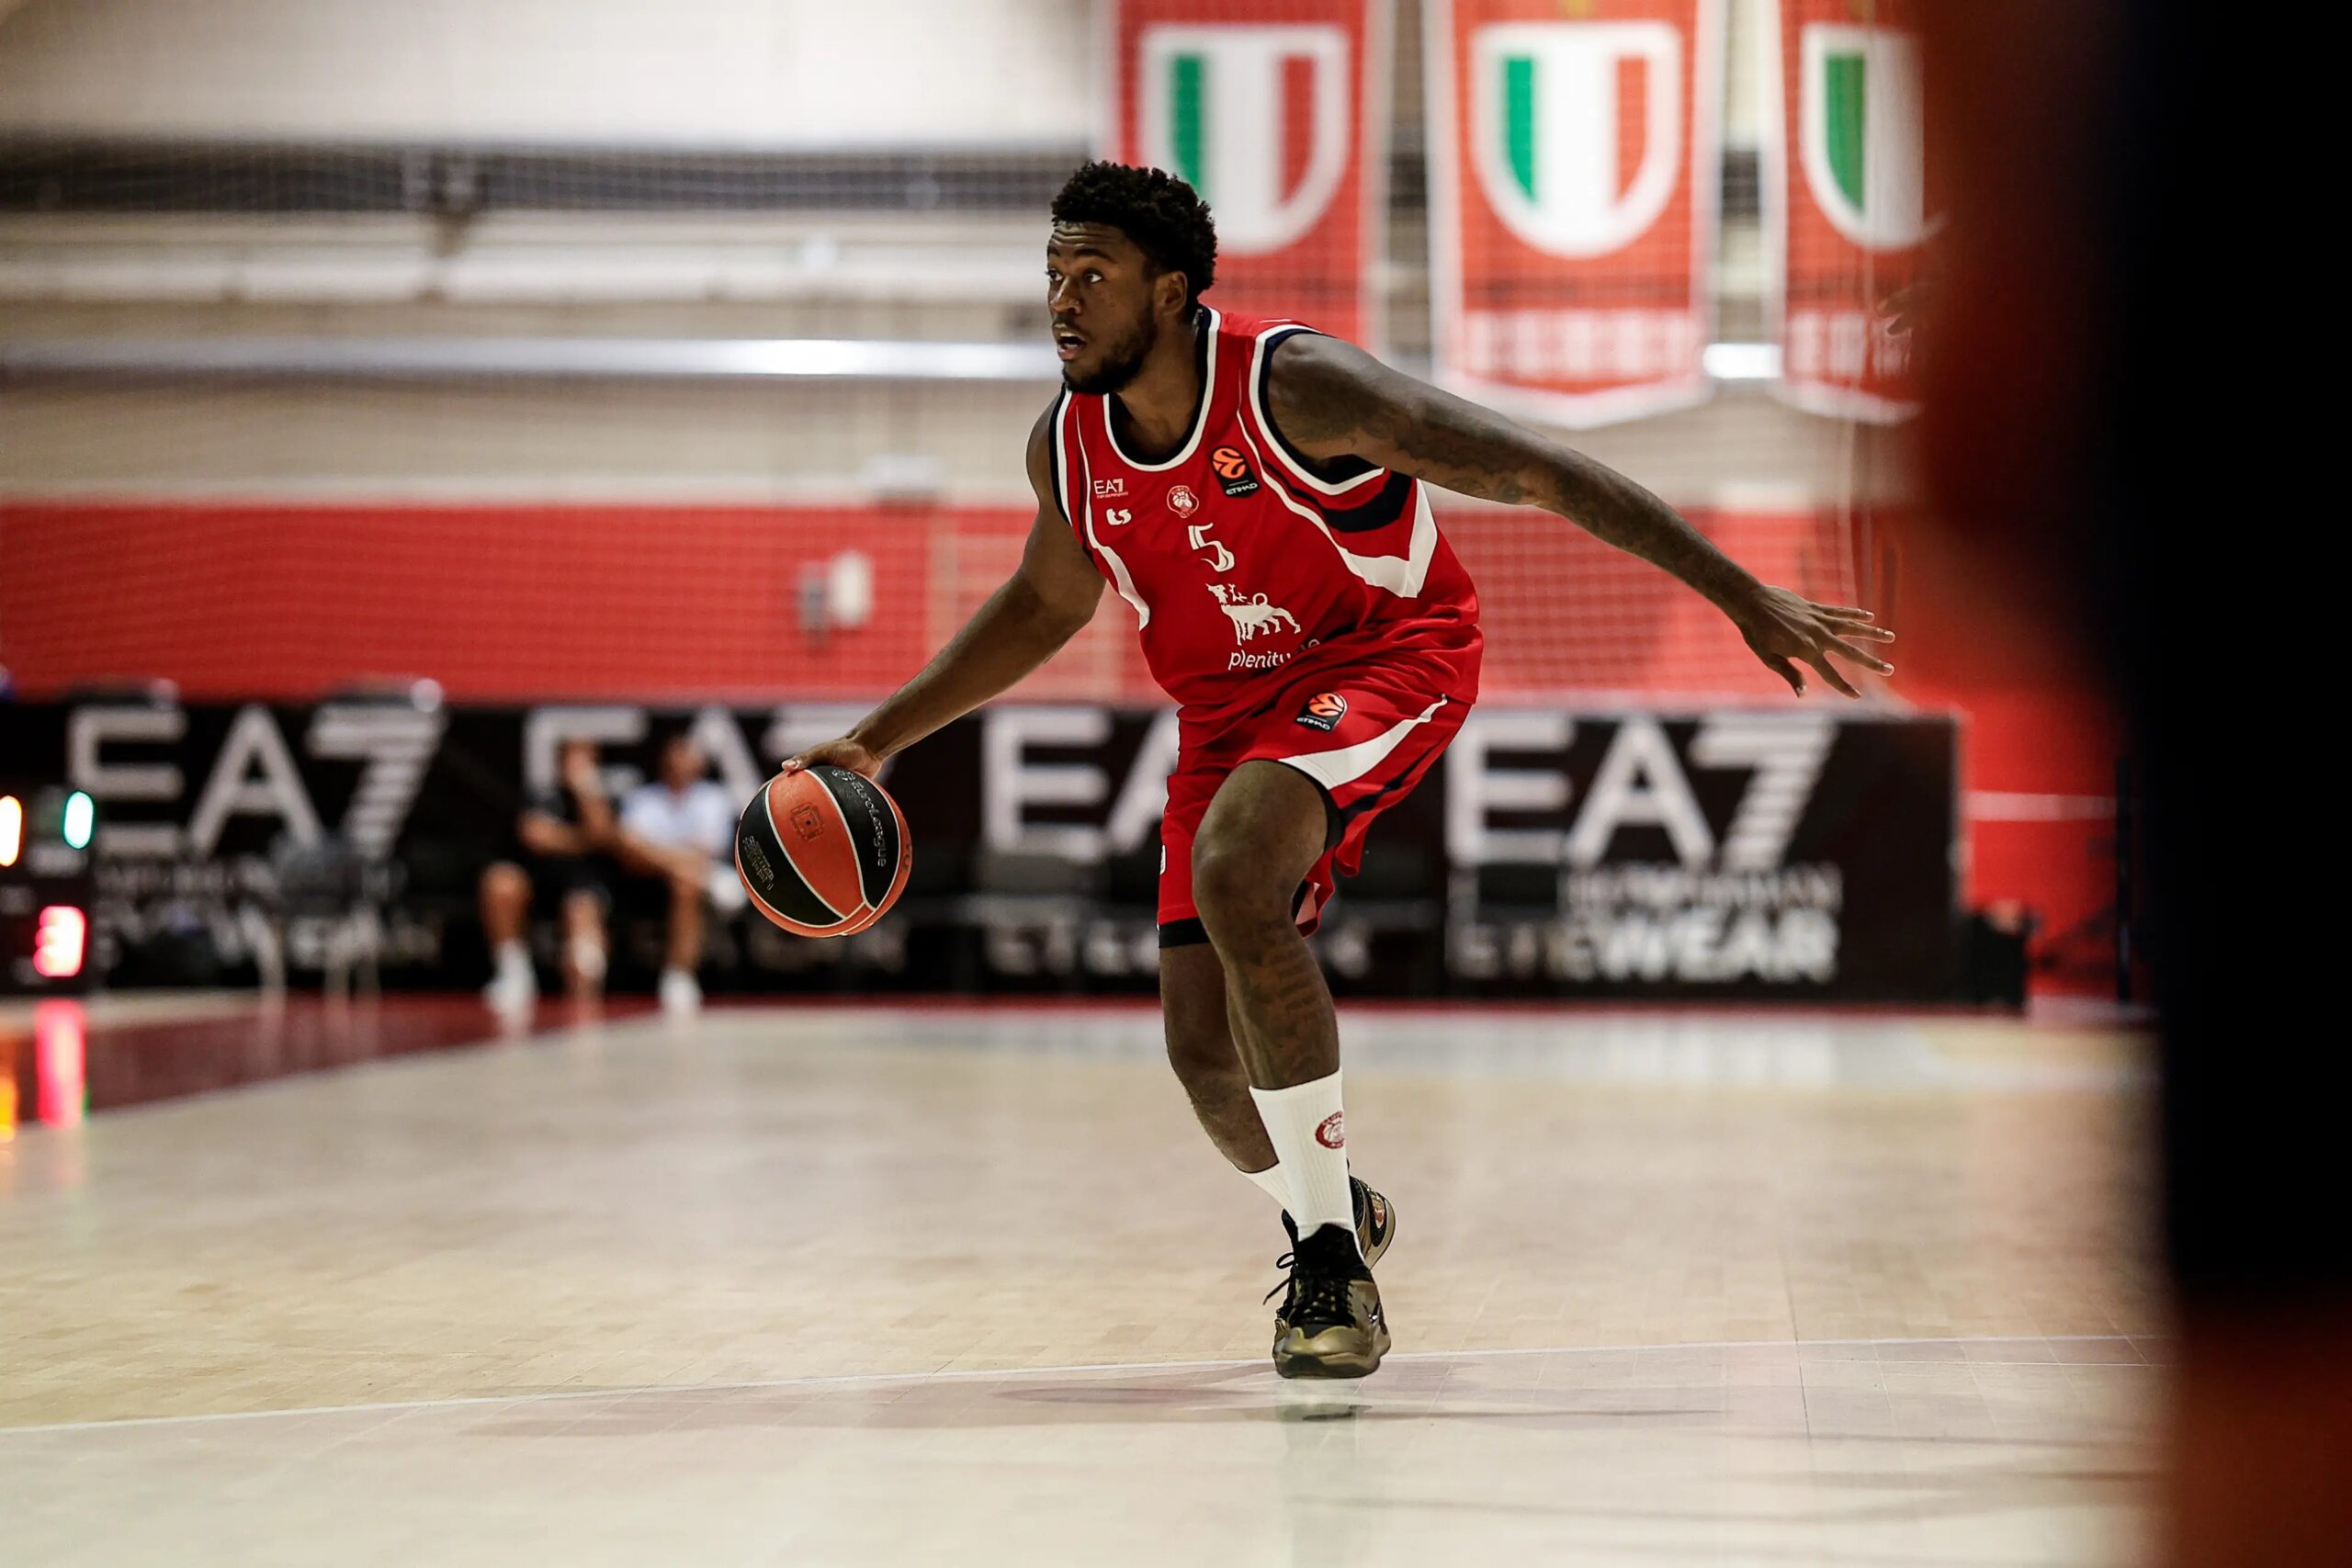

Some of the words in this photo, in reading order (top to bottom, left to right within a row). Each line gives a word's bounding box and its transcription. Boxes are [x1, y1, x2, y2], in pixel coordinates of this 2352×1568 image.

[1093, 478, 1124, 495] EA7
[1188, 522, 1235, 572] 5
[68, 705, 445, 860] EA7
[1445, 711, 1840, 871] EA7
